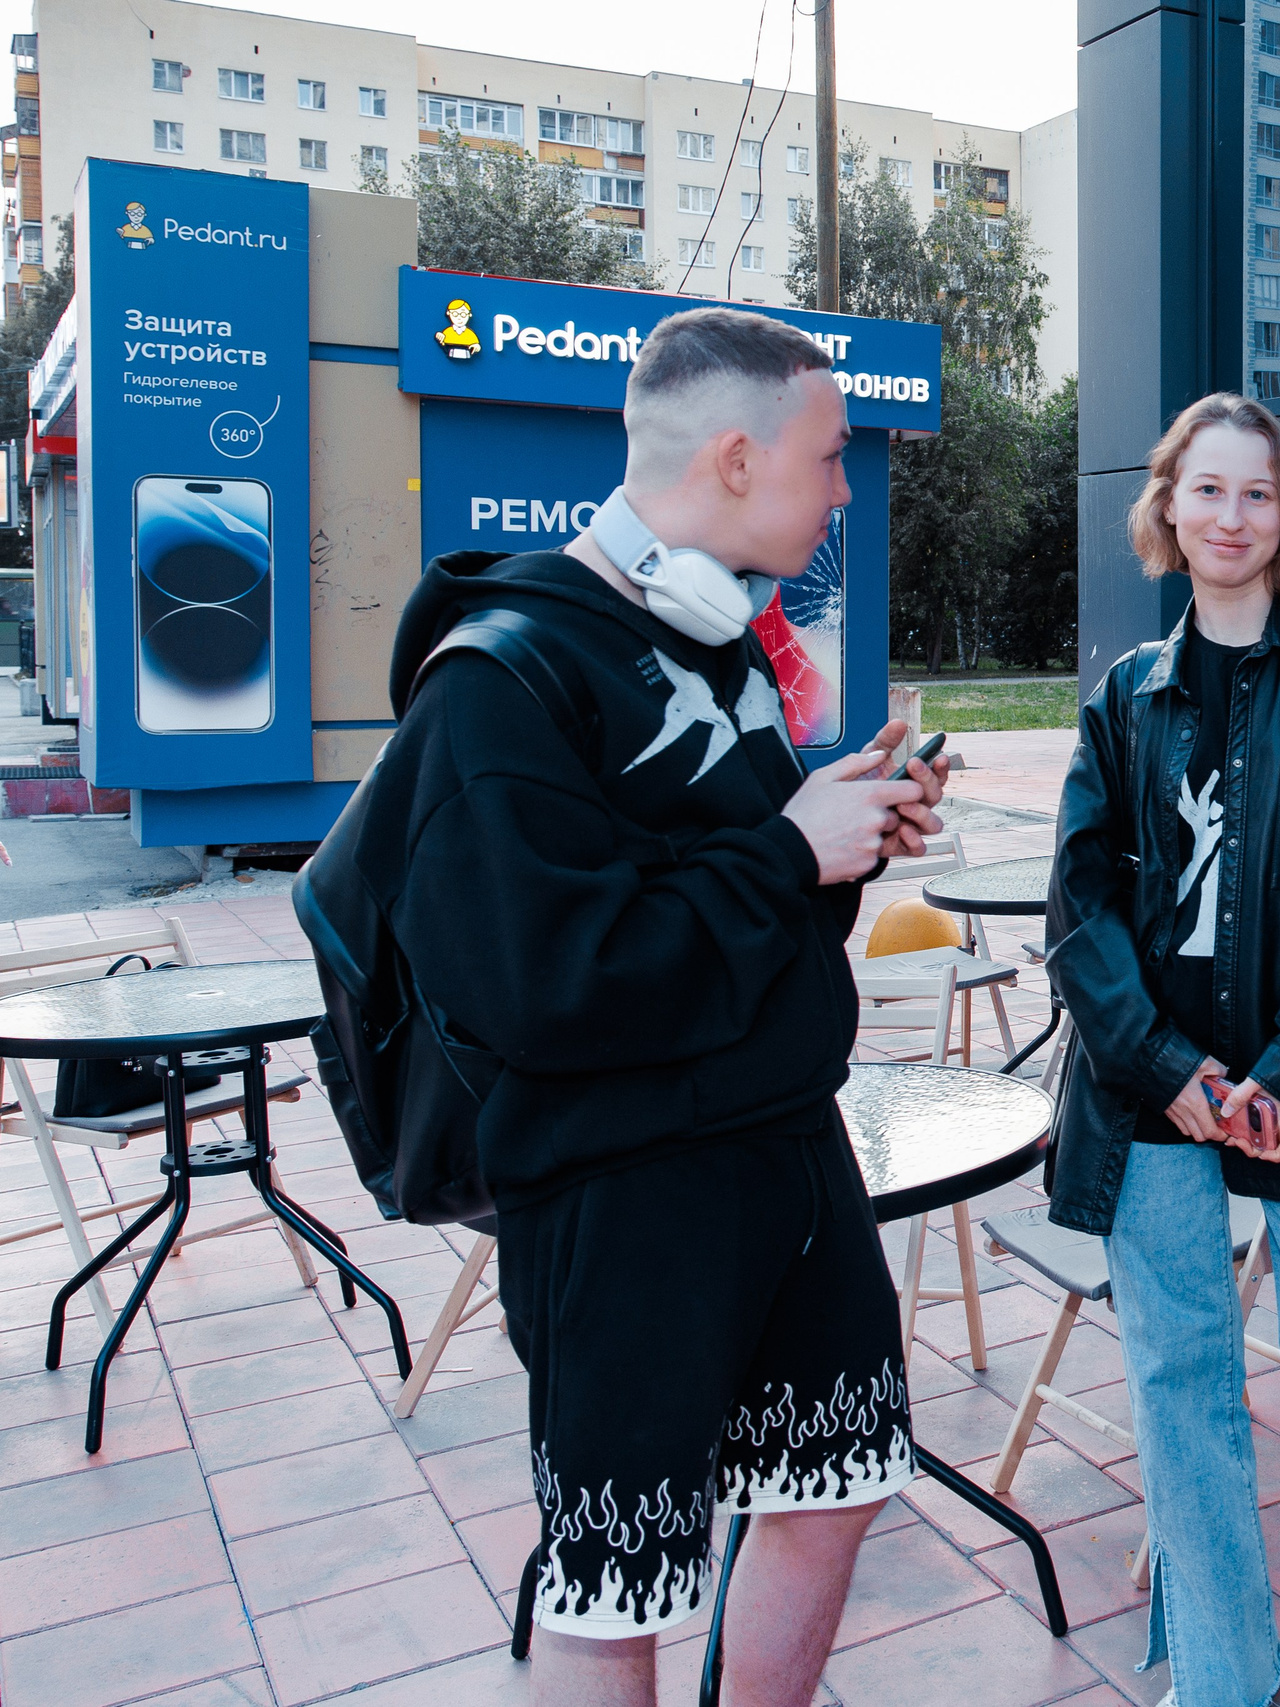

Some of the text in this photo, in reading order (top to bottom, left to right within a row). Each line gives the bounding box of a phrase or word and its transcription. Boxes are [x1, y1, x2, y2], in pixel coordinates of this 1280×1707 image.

[164, 218, 287, 250] Pedant.ru
[124, 309, 232, 336] Защита
[494, 314, 641, 362] Pedant
[124, 341, 267, 366] устройств
[123, 372, 238, 391] Гидрогелевое
[123, 393, 202, 407] покрытие
[220, 428, 256, 443] 360°
[471, 497, 601, 533] РЕМО
